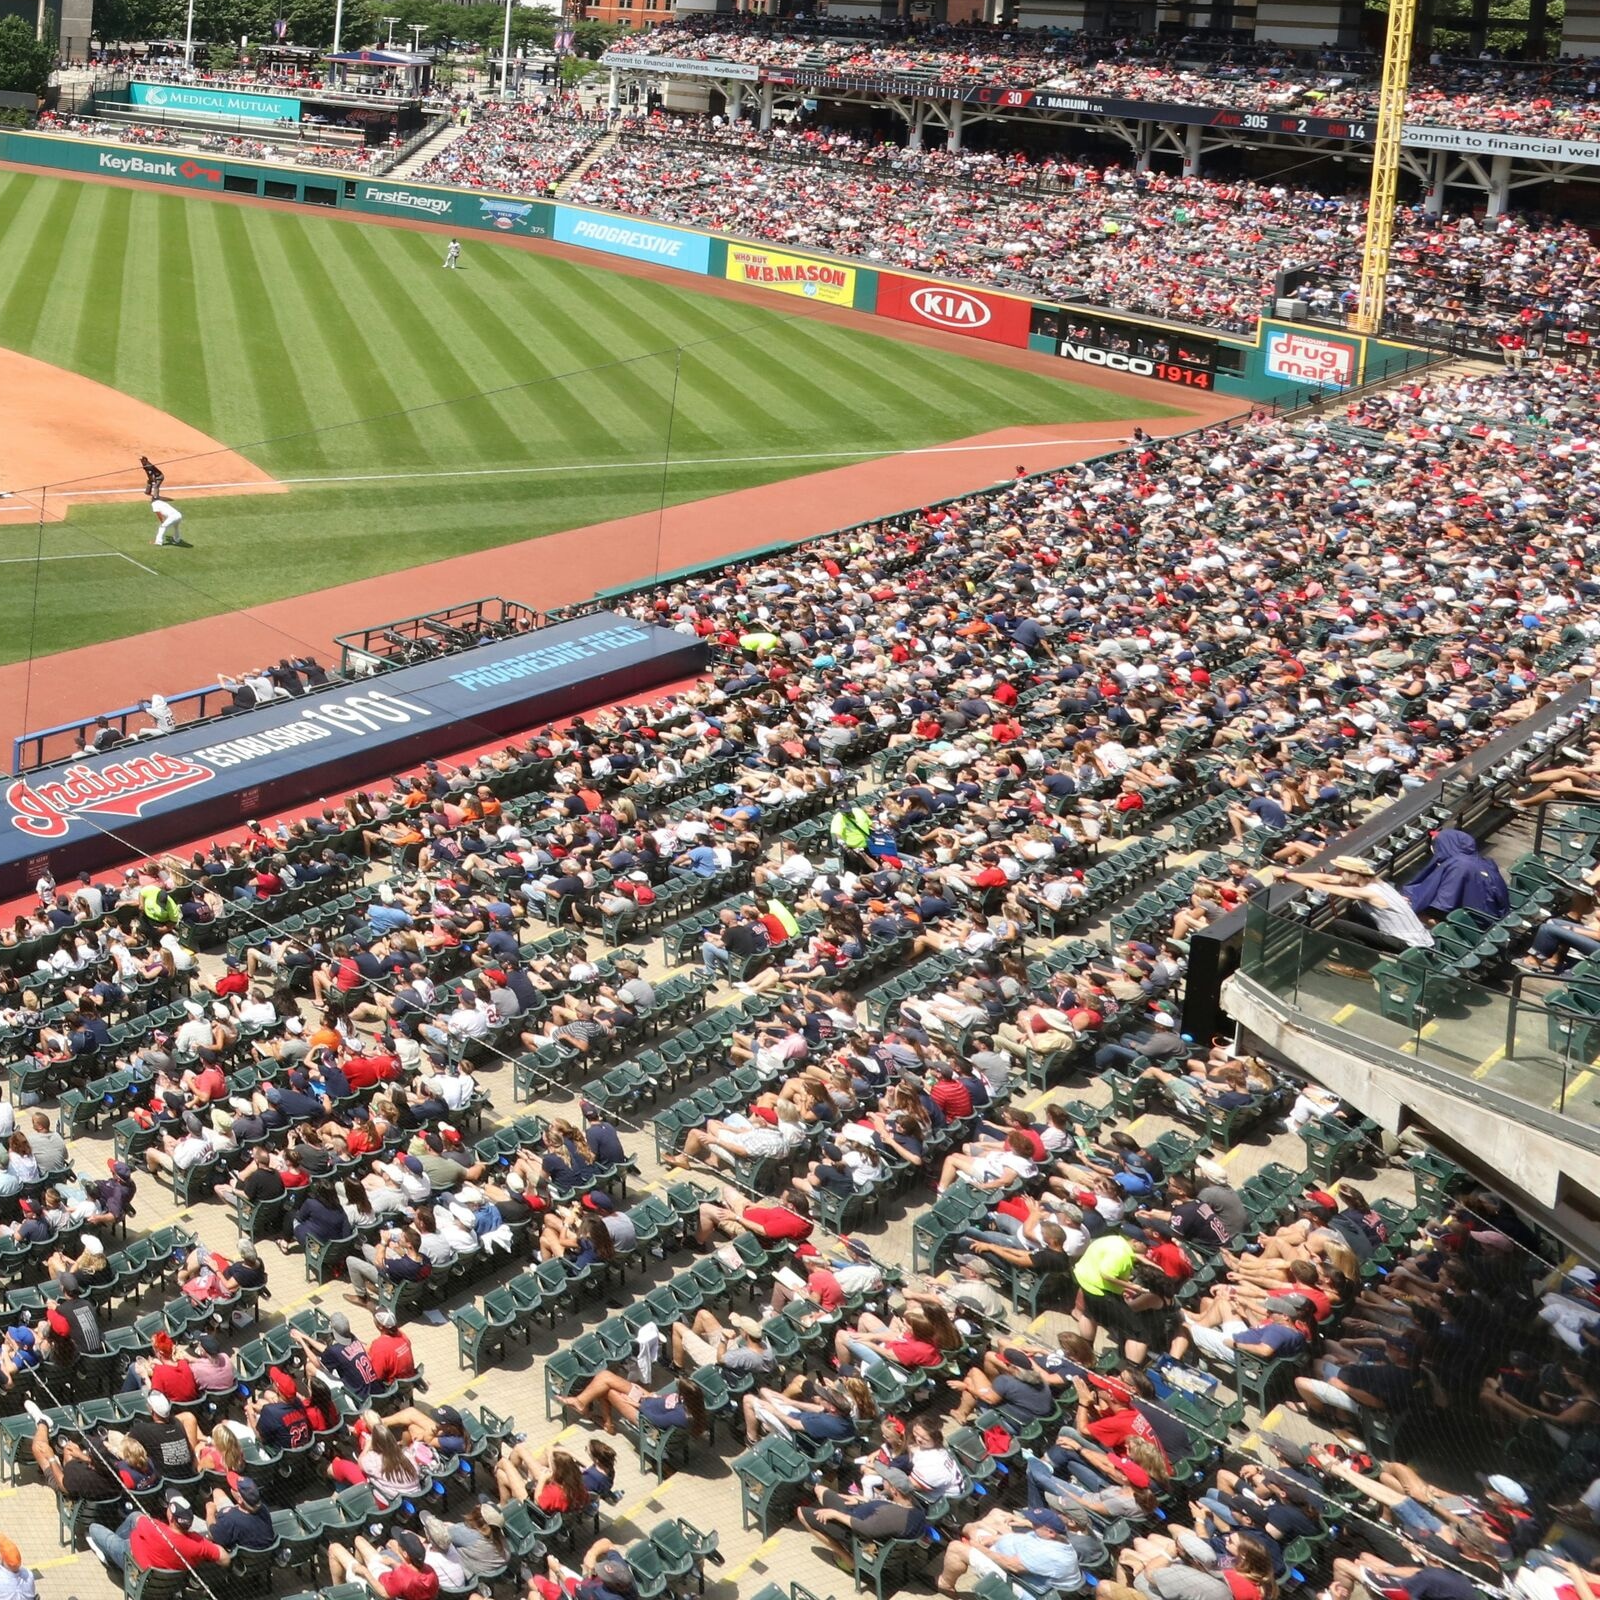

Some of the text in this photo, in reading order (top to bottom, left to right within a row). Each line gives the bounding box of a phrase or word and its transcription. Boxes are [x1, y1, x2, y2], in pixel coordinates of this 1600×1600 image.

[604, 55, 711, 73] Commit to financial wellness.
[714, 66, 741, 75] KeyBank
[171, 92, 280, 113] MEDICAL MUTUAL
[100, 153, 176, 177] KeyBank
[366, 187, 452, 213] FirstEnergy
[530, 226, 545, 234] 375
[573, 220, 684, 257] PROGRESSIVE
[734, 252, 768, 264] WHO BUT
[744, 263, 847, 288] W.B.MASON
[924, 292, 977, 323] KIA
[1274, 334, 1338, 368] drug
[1291, 335, 1330, 348] DISCOUNT
[1060, 341, 1152, 376] NOCO
[1155, 363, 1209, 389] 1914
[1277, 361, 1351, 387] mart
[448, 625, 650, 693] PROGRESSIVE FIELD
[6, 689, 433, 839] Indians ESTABLISHED 1901
[355, 1357, 378, 1385] 12
